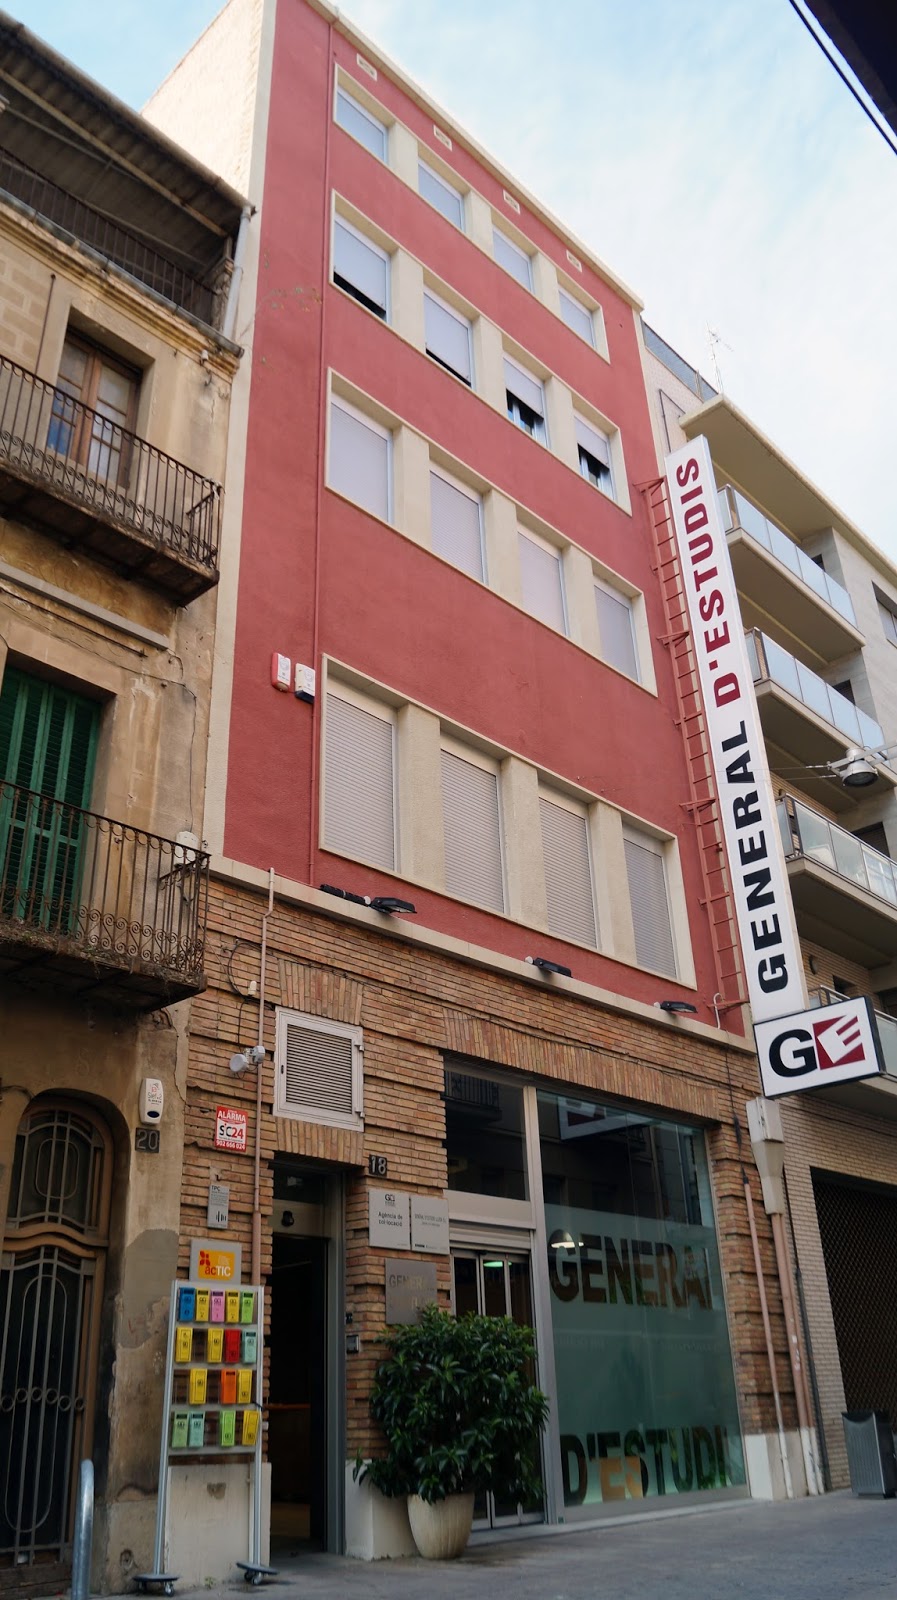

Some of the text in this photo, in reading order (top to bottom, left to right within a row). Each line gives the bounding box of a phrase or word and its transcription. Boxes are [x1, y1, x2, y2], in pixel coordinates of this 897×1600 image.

[676, 457, 789, 994] GENERAL D'ESTUDIS
[217, 1110, 246, 1122] ALARMA
[137, 1130, 159, 1150] 20
[371, 1156, 387, 1175] 18
[204, 1265, 231, 1277] acTIC
